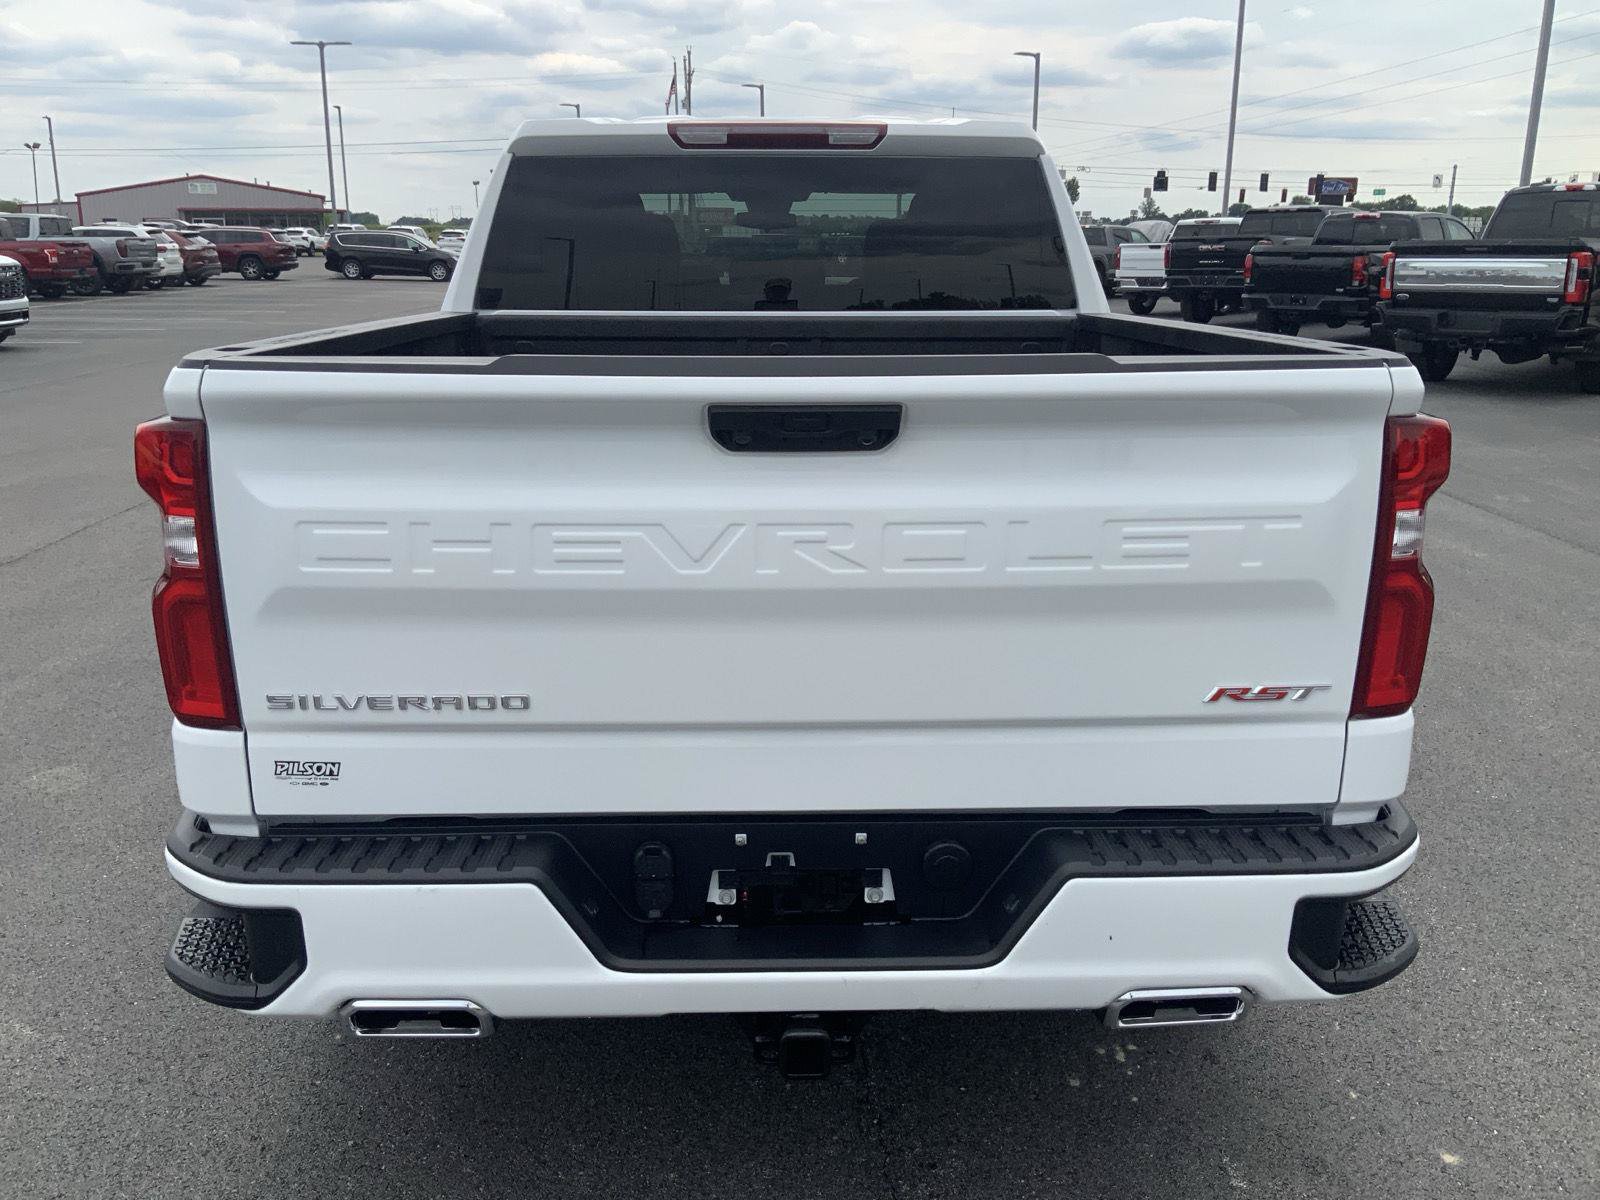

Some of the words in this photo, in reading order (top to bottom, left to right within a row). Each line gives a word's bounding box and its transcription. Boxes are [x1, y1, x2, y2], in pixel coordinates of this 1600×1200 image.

[295, 515, 1303, 575] CHEVROLET
[266, 694, 531, 711] SILVERADO
[1201, 685, 1332, 703] RST
[274, 760, 341, 777] PILSON
